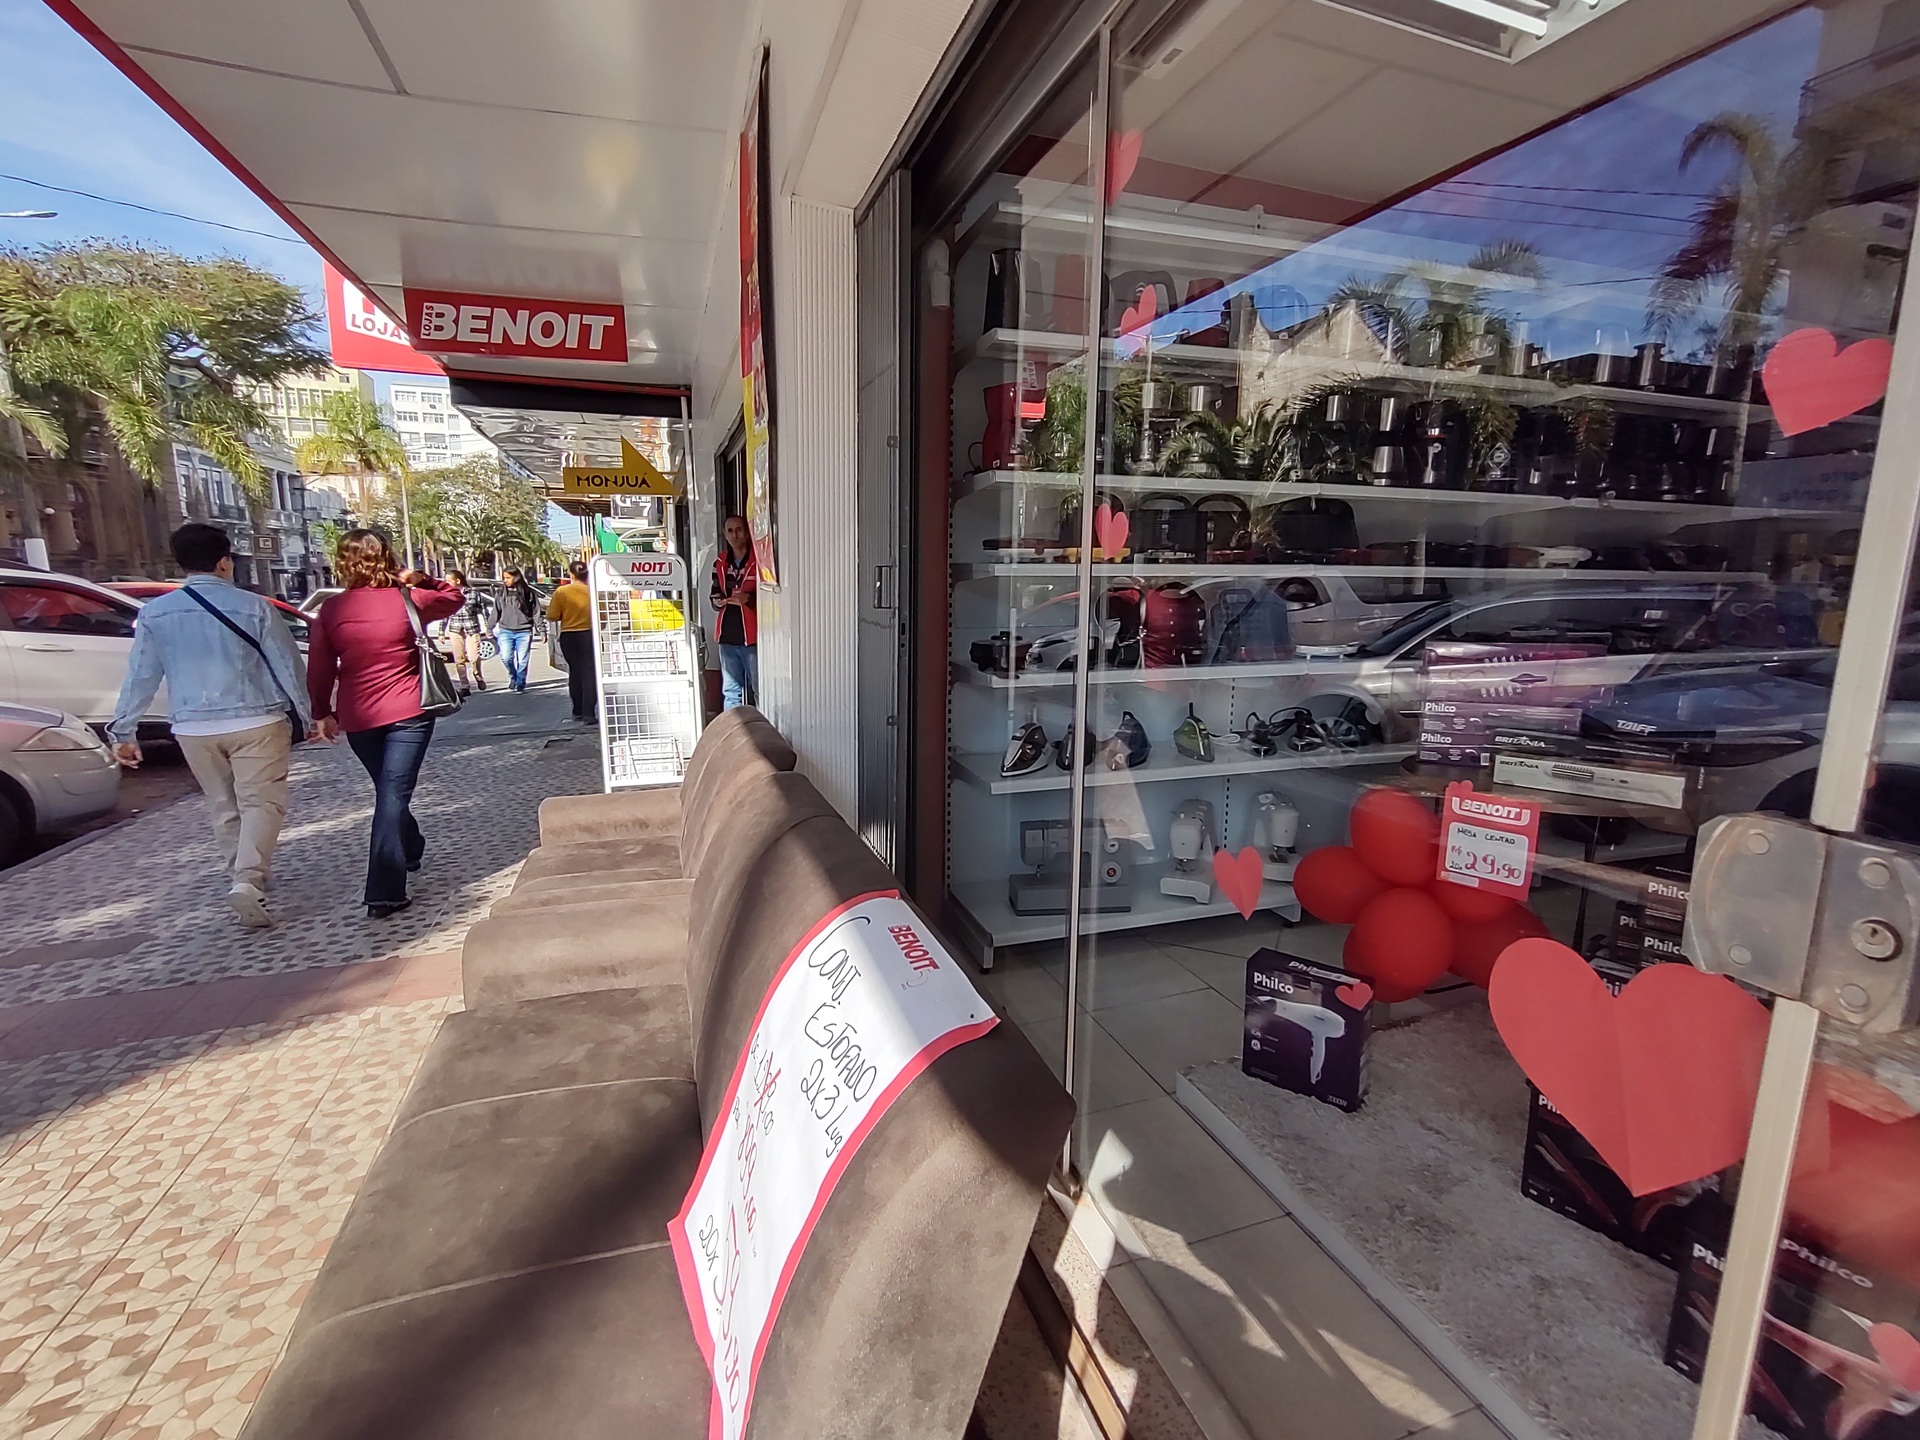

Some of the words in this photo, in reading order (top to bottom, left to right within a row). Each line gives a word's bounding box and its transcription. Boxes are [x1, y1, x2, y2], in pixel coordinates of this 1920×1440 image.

[351, 313, 410, 343] LOJA
[422, 304, 434, 337] LOJAS
[422, 302, 615, 350] BENOIT
[576, 472, 651, 488] MONJUÁ
[1425, 702, 1456, 713] Philco
[1421, 732, 1452, 743] Philco
[1461, 798, 1520, 819] BENOIT
[1464, 851, 1521, 879] 29,90
[887, 924, 941, 972] BENOIT
[1253, 971, 1294, 995] Philco
[1778, 1237, 1874, 1290] Philco
